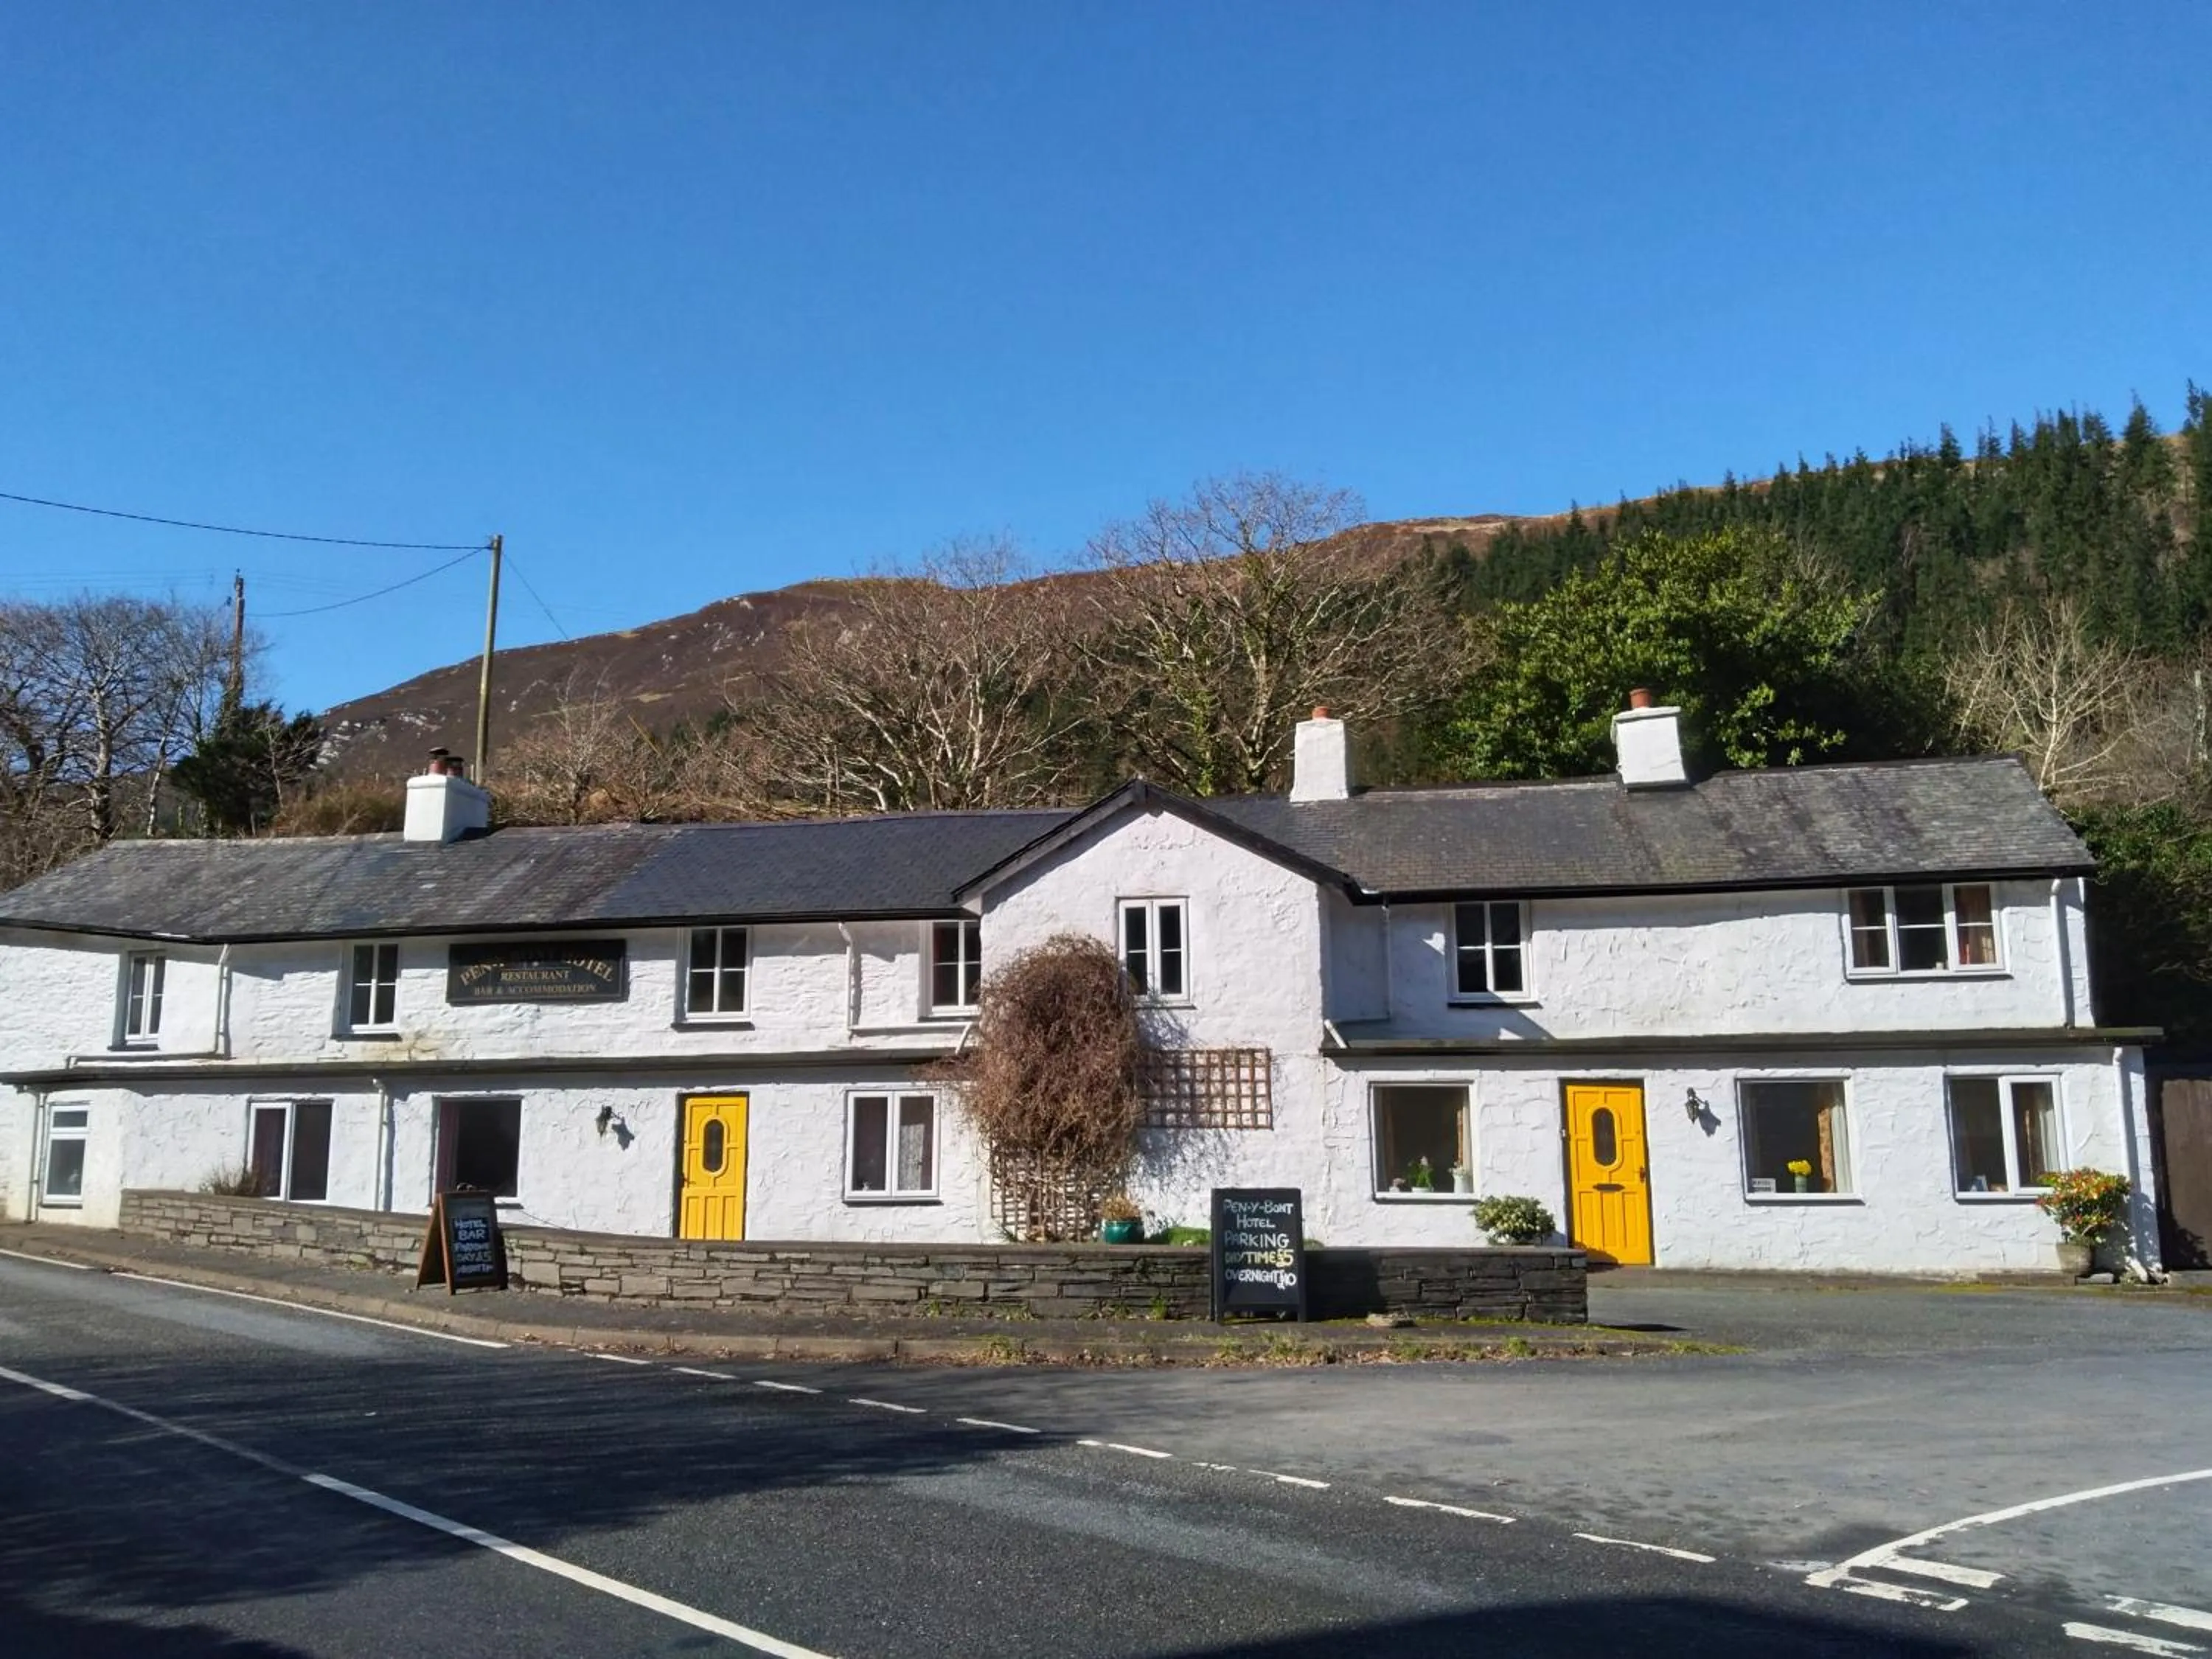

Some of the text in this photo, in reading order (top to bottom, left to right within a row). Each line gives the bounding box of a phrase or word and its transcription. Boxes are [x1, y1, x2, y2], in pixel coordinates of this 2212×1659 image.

[500, 970, 570, 981] RESTAURANT
[474, 985, 493, 995] BAR
[509, 983, 597, 994] ACCOMMODATION
[1237, 1214, 1276, 1228] HOTEL
[457, 1228, 485, 1241] BAR
[1224, 1230, 1290, 1248] PARKING
[1225, 1268, 1282, 1284] OVERNIGHT
